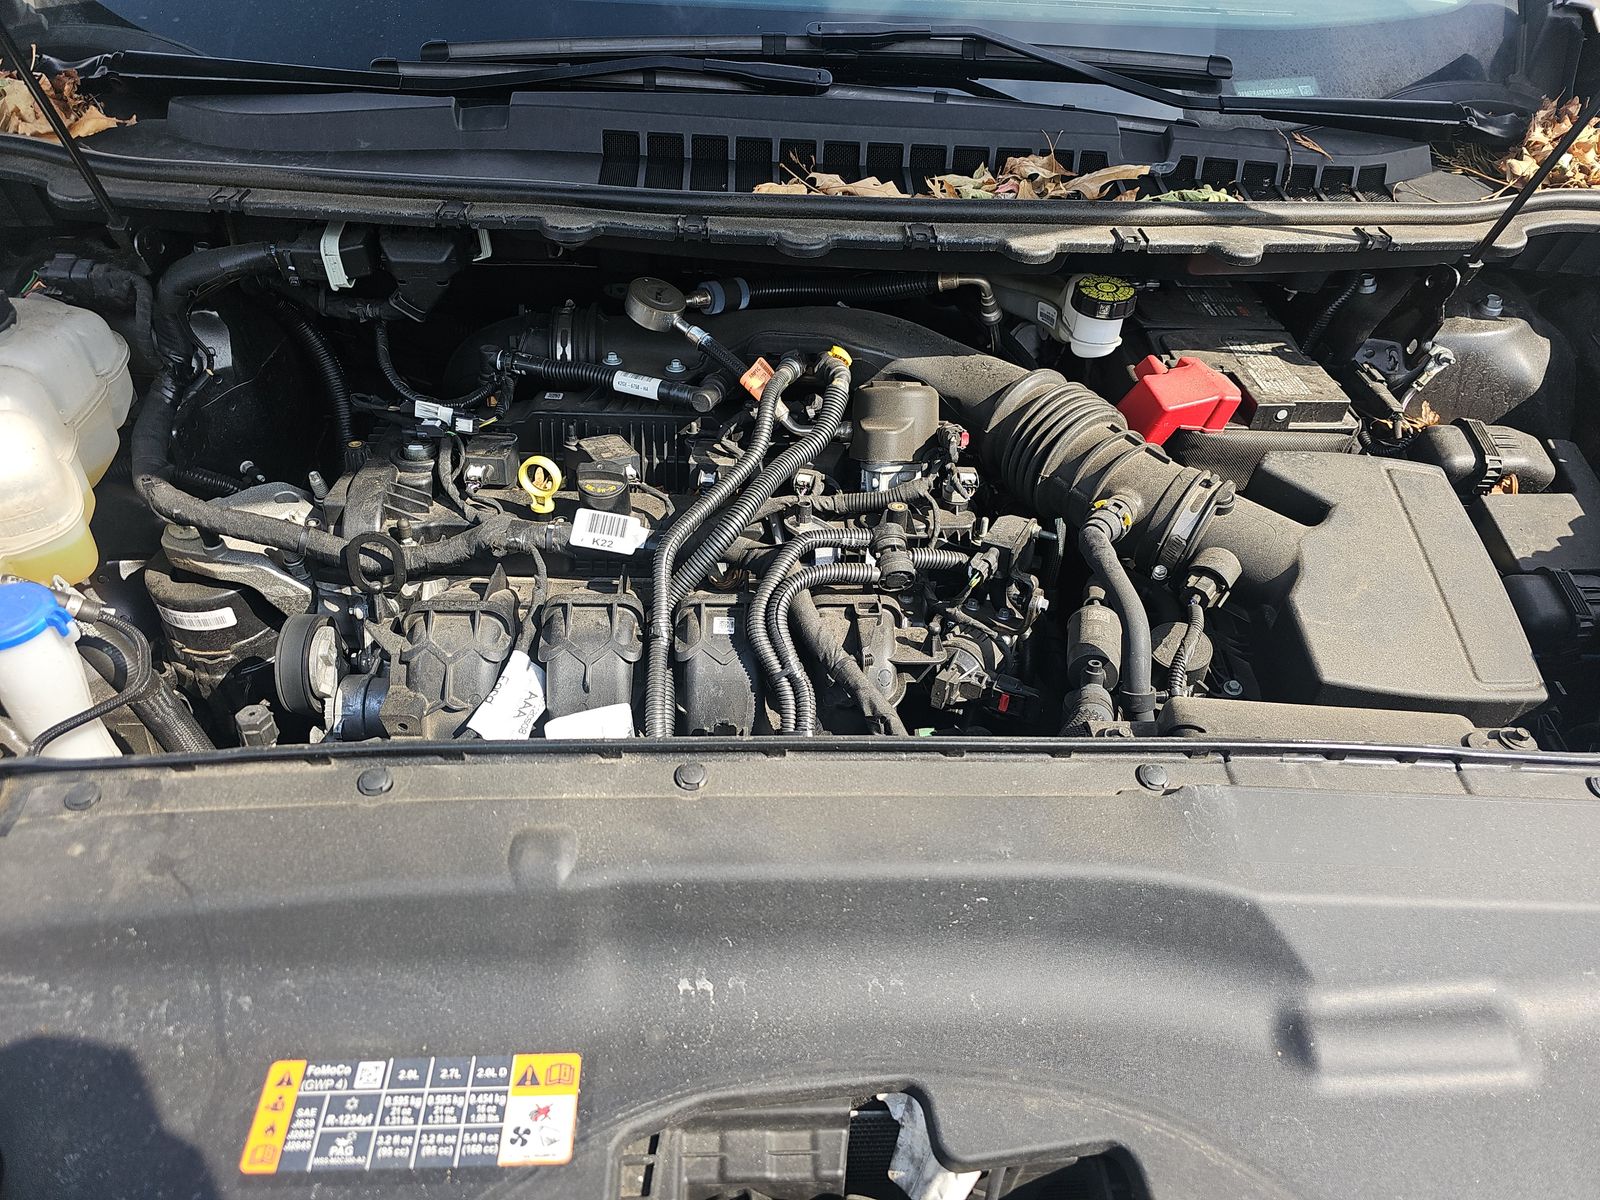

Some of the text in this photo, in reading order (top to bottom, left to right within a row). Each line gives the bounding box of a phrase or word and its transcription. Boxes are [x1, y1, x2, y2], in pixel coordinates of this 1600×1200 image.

[592, 538, 614, 549] K22
[512, 690, 538, 719] AAA
[306, 1064, 352, 1077] FoMoCo
[398, 1069, 420, 1080] 2.0L
[440, 1067, 461, 1080] 2.7L
[301, 1078, 348, 1092] (GWP 4)
[410, 1095, 422, 1109] kg
[452, 1094, 465, 1108] kg
[494, 1092, 507, 1107] kg
[295, 1107, 318, 1118] SAE
[401, 1107, 412, 1116] oz
[444, 1106, 455, 1115] oz
[486, 1105, 497, 1114] oz
[324, 1113, 374, 1127] R-1234yf
[377, 1134, 392, 1146] 3.2
[401, 1135, 414, 1146] oz
[420, 1133, 435, 1145] 3.2
[444, 1135, 457, 1145] oz
[463, 1132, 478, 1144] 5.4
[486, 1133, 499, 1143] oz
[328, 1145, 354, 1157] PAG
[393, 1147, 411, 1158] cc)
[437, 1146, 454, 1157] cc)
[484, 1144, 499, 1155] cc)
